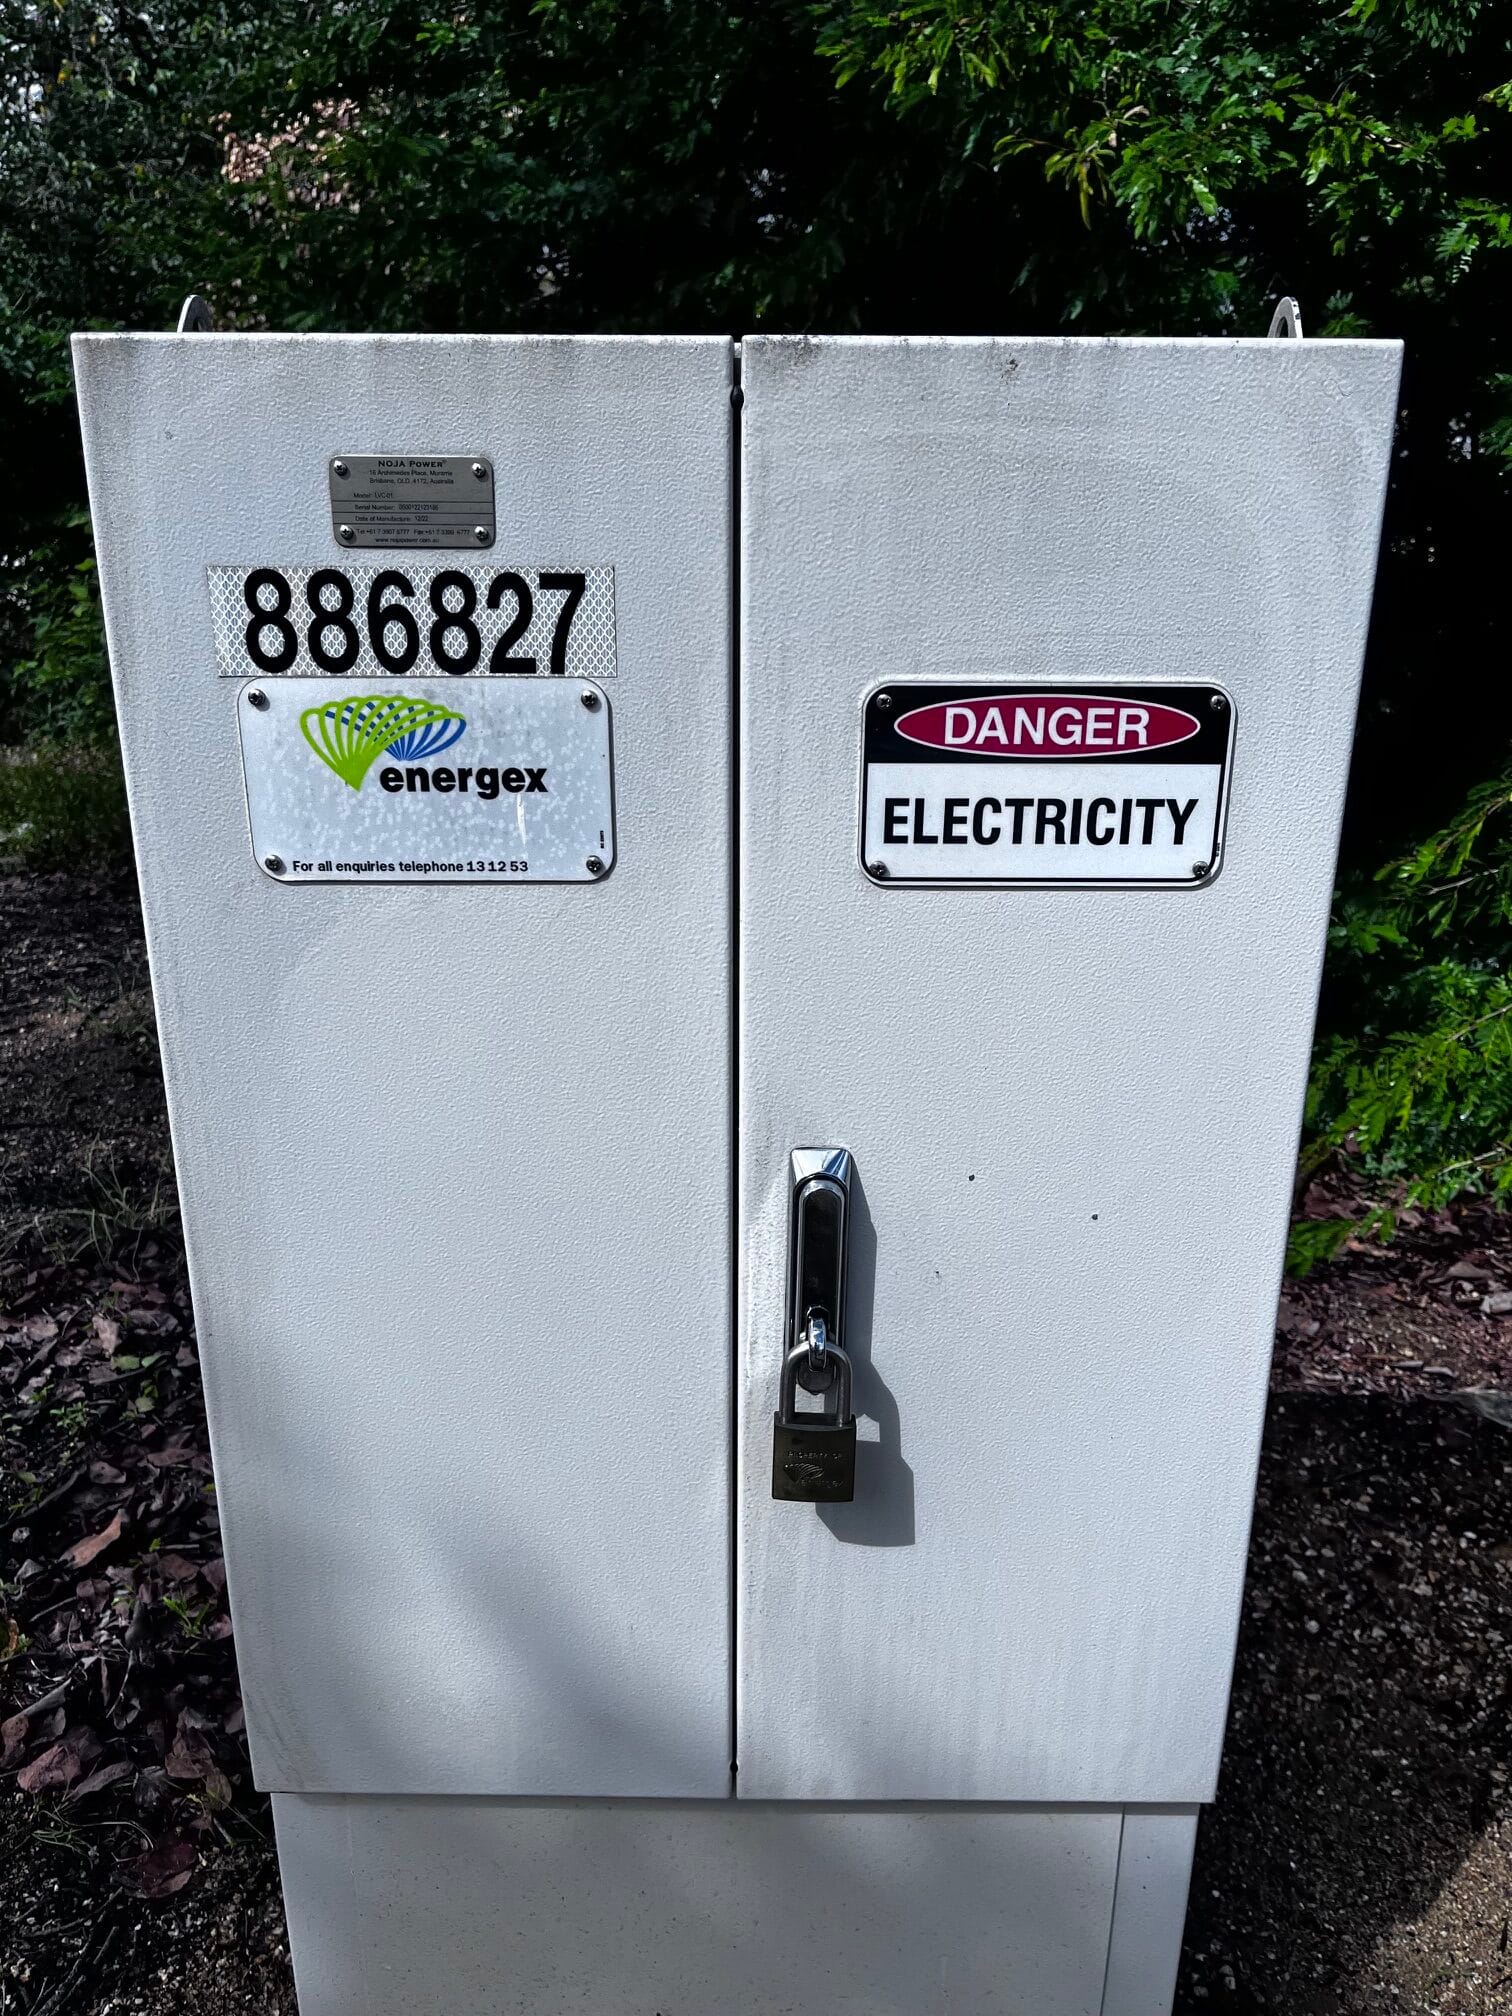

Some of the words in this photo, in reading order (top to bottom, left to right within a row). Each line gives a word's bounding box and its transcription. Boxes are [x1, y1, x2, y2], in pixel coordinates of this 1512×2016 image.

[378, 460, 406, 468] NOJA
[243, 568, 586, 676] 886827
[944, 707, 1150, 745] DANGER
[379, 765, 549, 800] energex
[883, 797, 1199, 846] ELECTRICITY
[292, 860, 314, 872] For
[318, 860, 333, 872] all
[335, 860, 396, 875] enquiries
[398, 860, 464, 875] telephone
